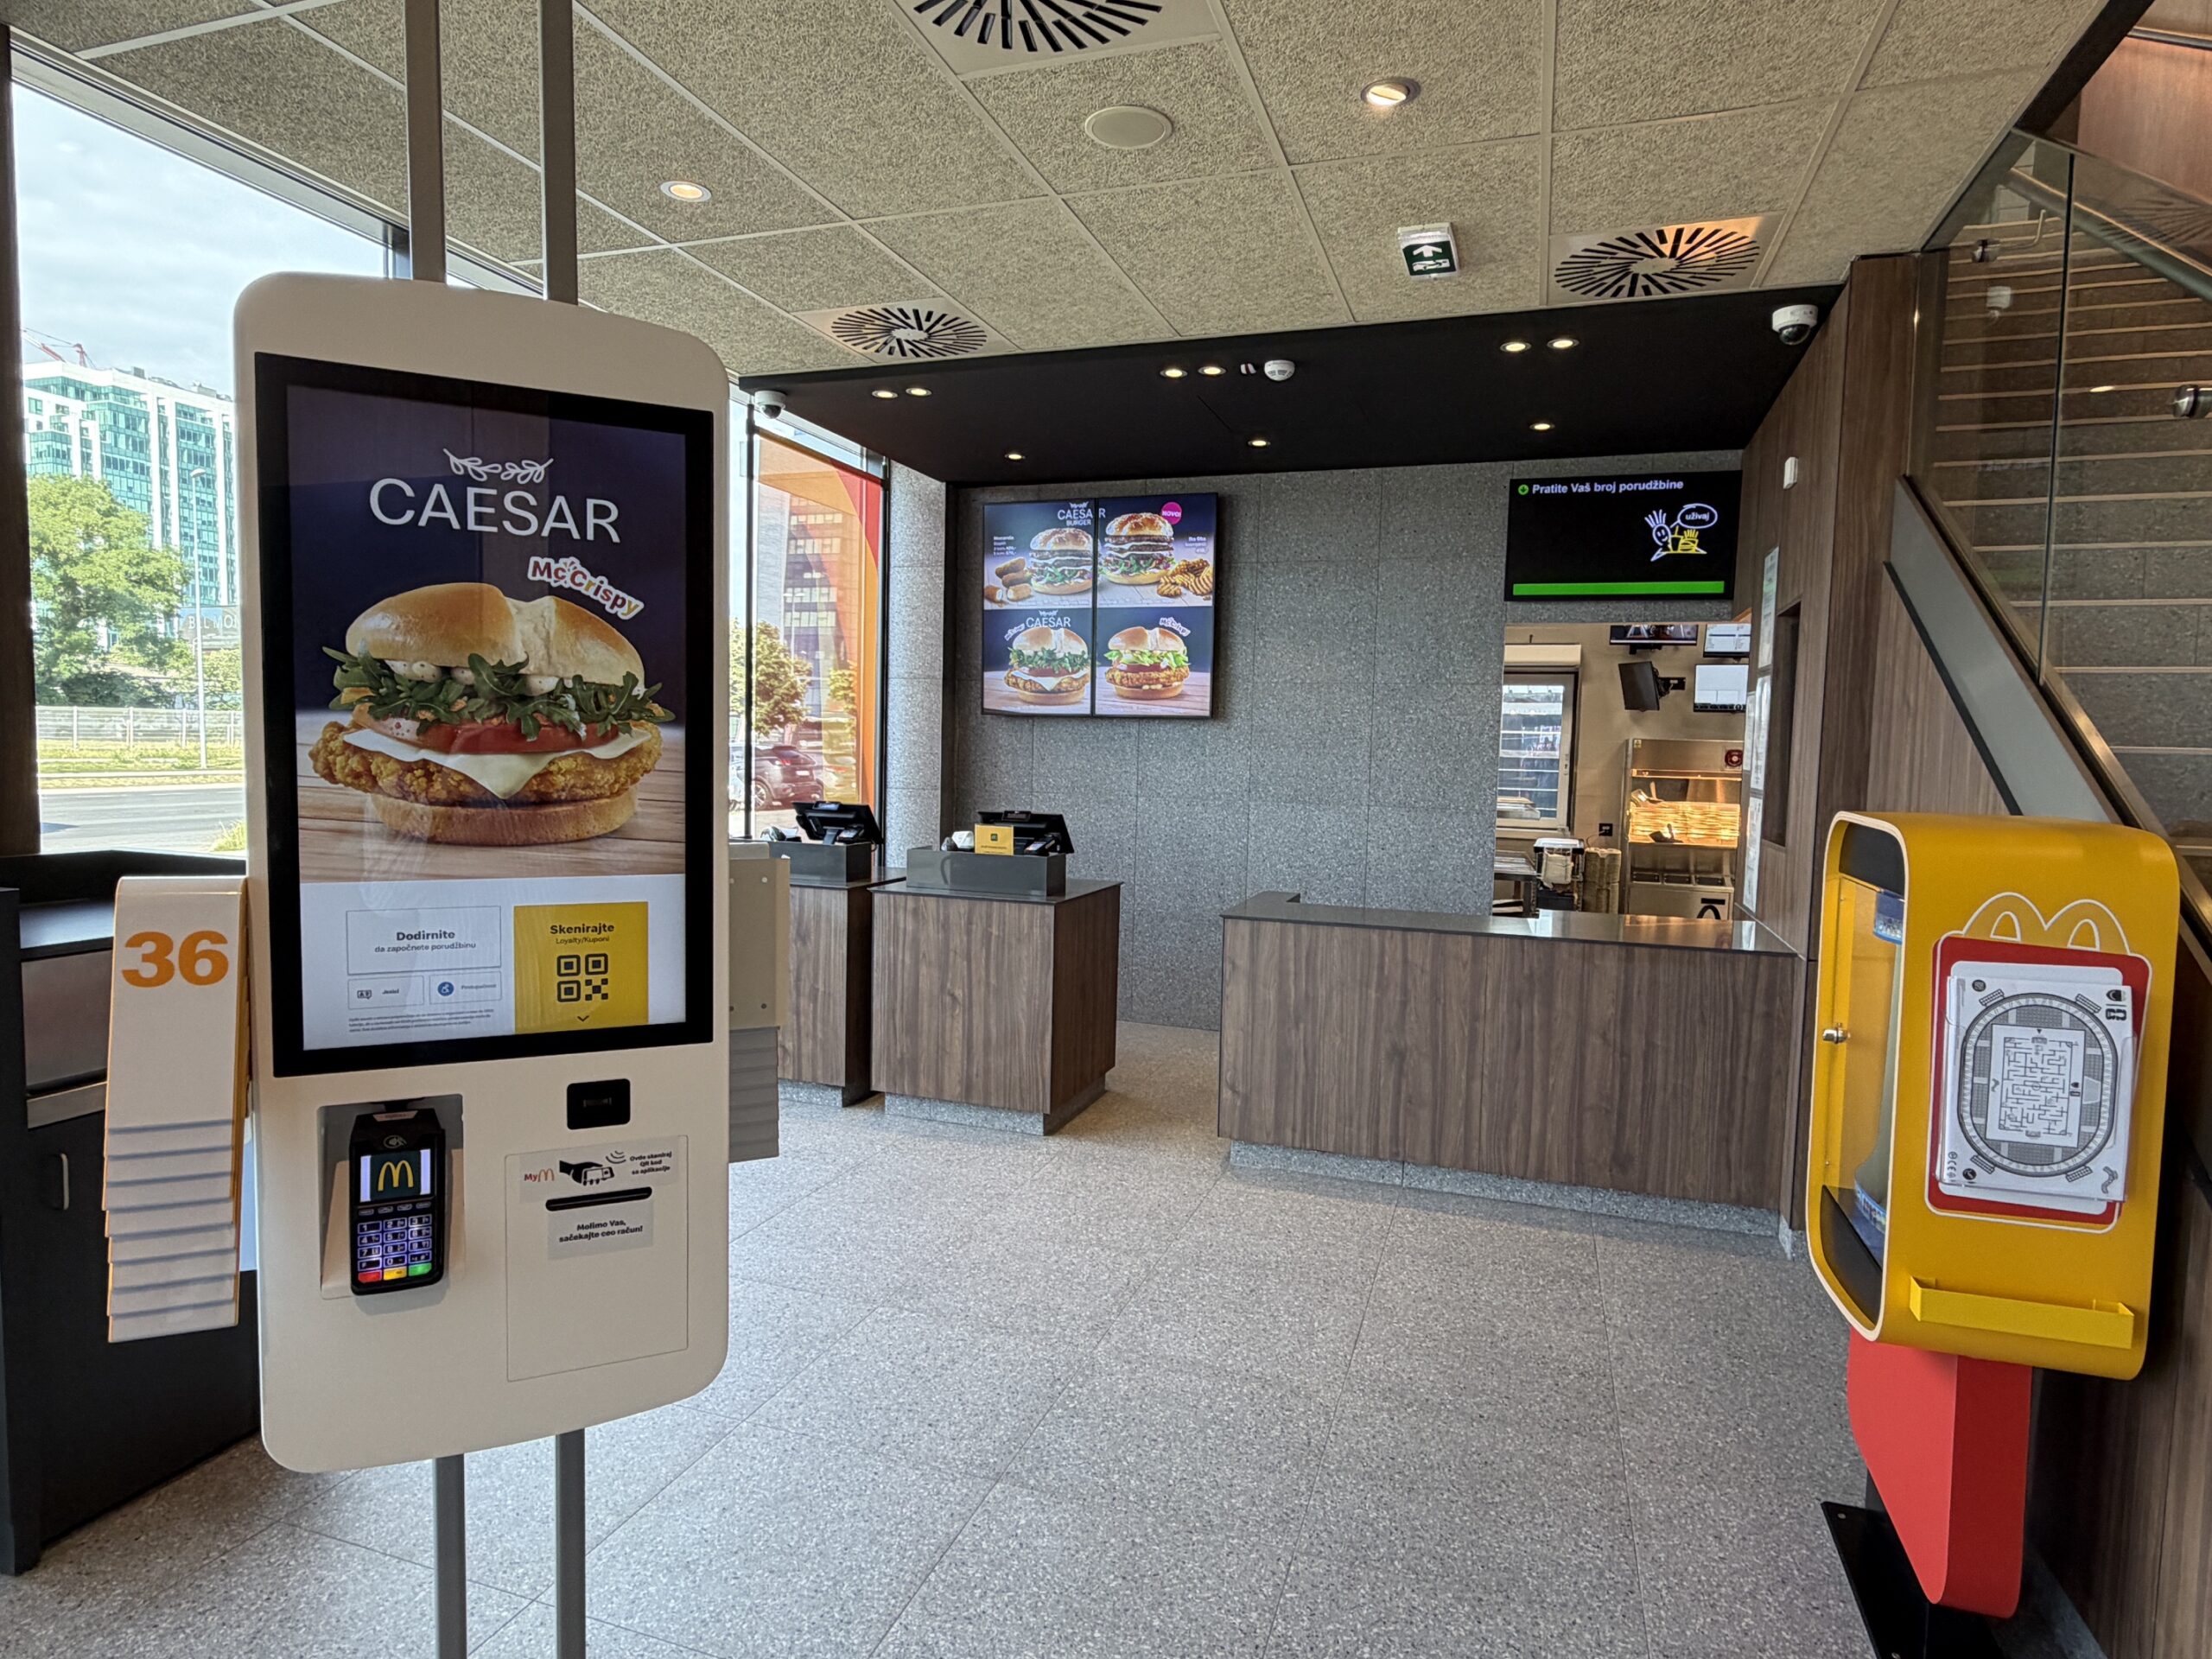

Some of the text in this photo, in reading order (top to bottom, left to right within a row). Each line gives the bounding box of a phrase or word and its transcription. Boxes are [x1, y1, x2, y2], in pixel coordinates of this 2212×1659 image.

[1532, 479, 1684, 494] Pratite Vaš broj porudžbine
[369, 478, 620, 543] CAESAR
[1685, 512, 1710, 522] uživaj
[528, 556, 645, 620] McCrispy
[1026, 616, 1071, 628] CAESAR
[550, 922, 615, 935] Skenirajte
[396, 930, 456, 942] Dodirnite
[387, 944, 430, 954] započnete
[431, 942, 476, 952] porudžbinu
[121, 930, 229, 988] 36
[576, 1219, 626, 1231] Molimo Vas,
[559, 1230, 600, 1243] sačekajte
[617, 1225, 644, 1236] račun!
